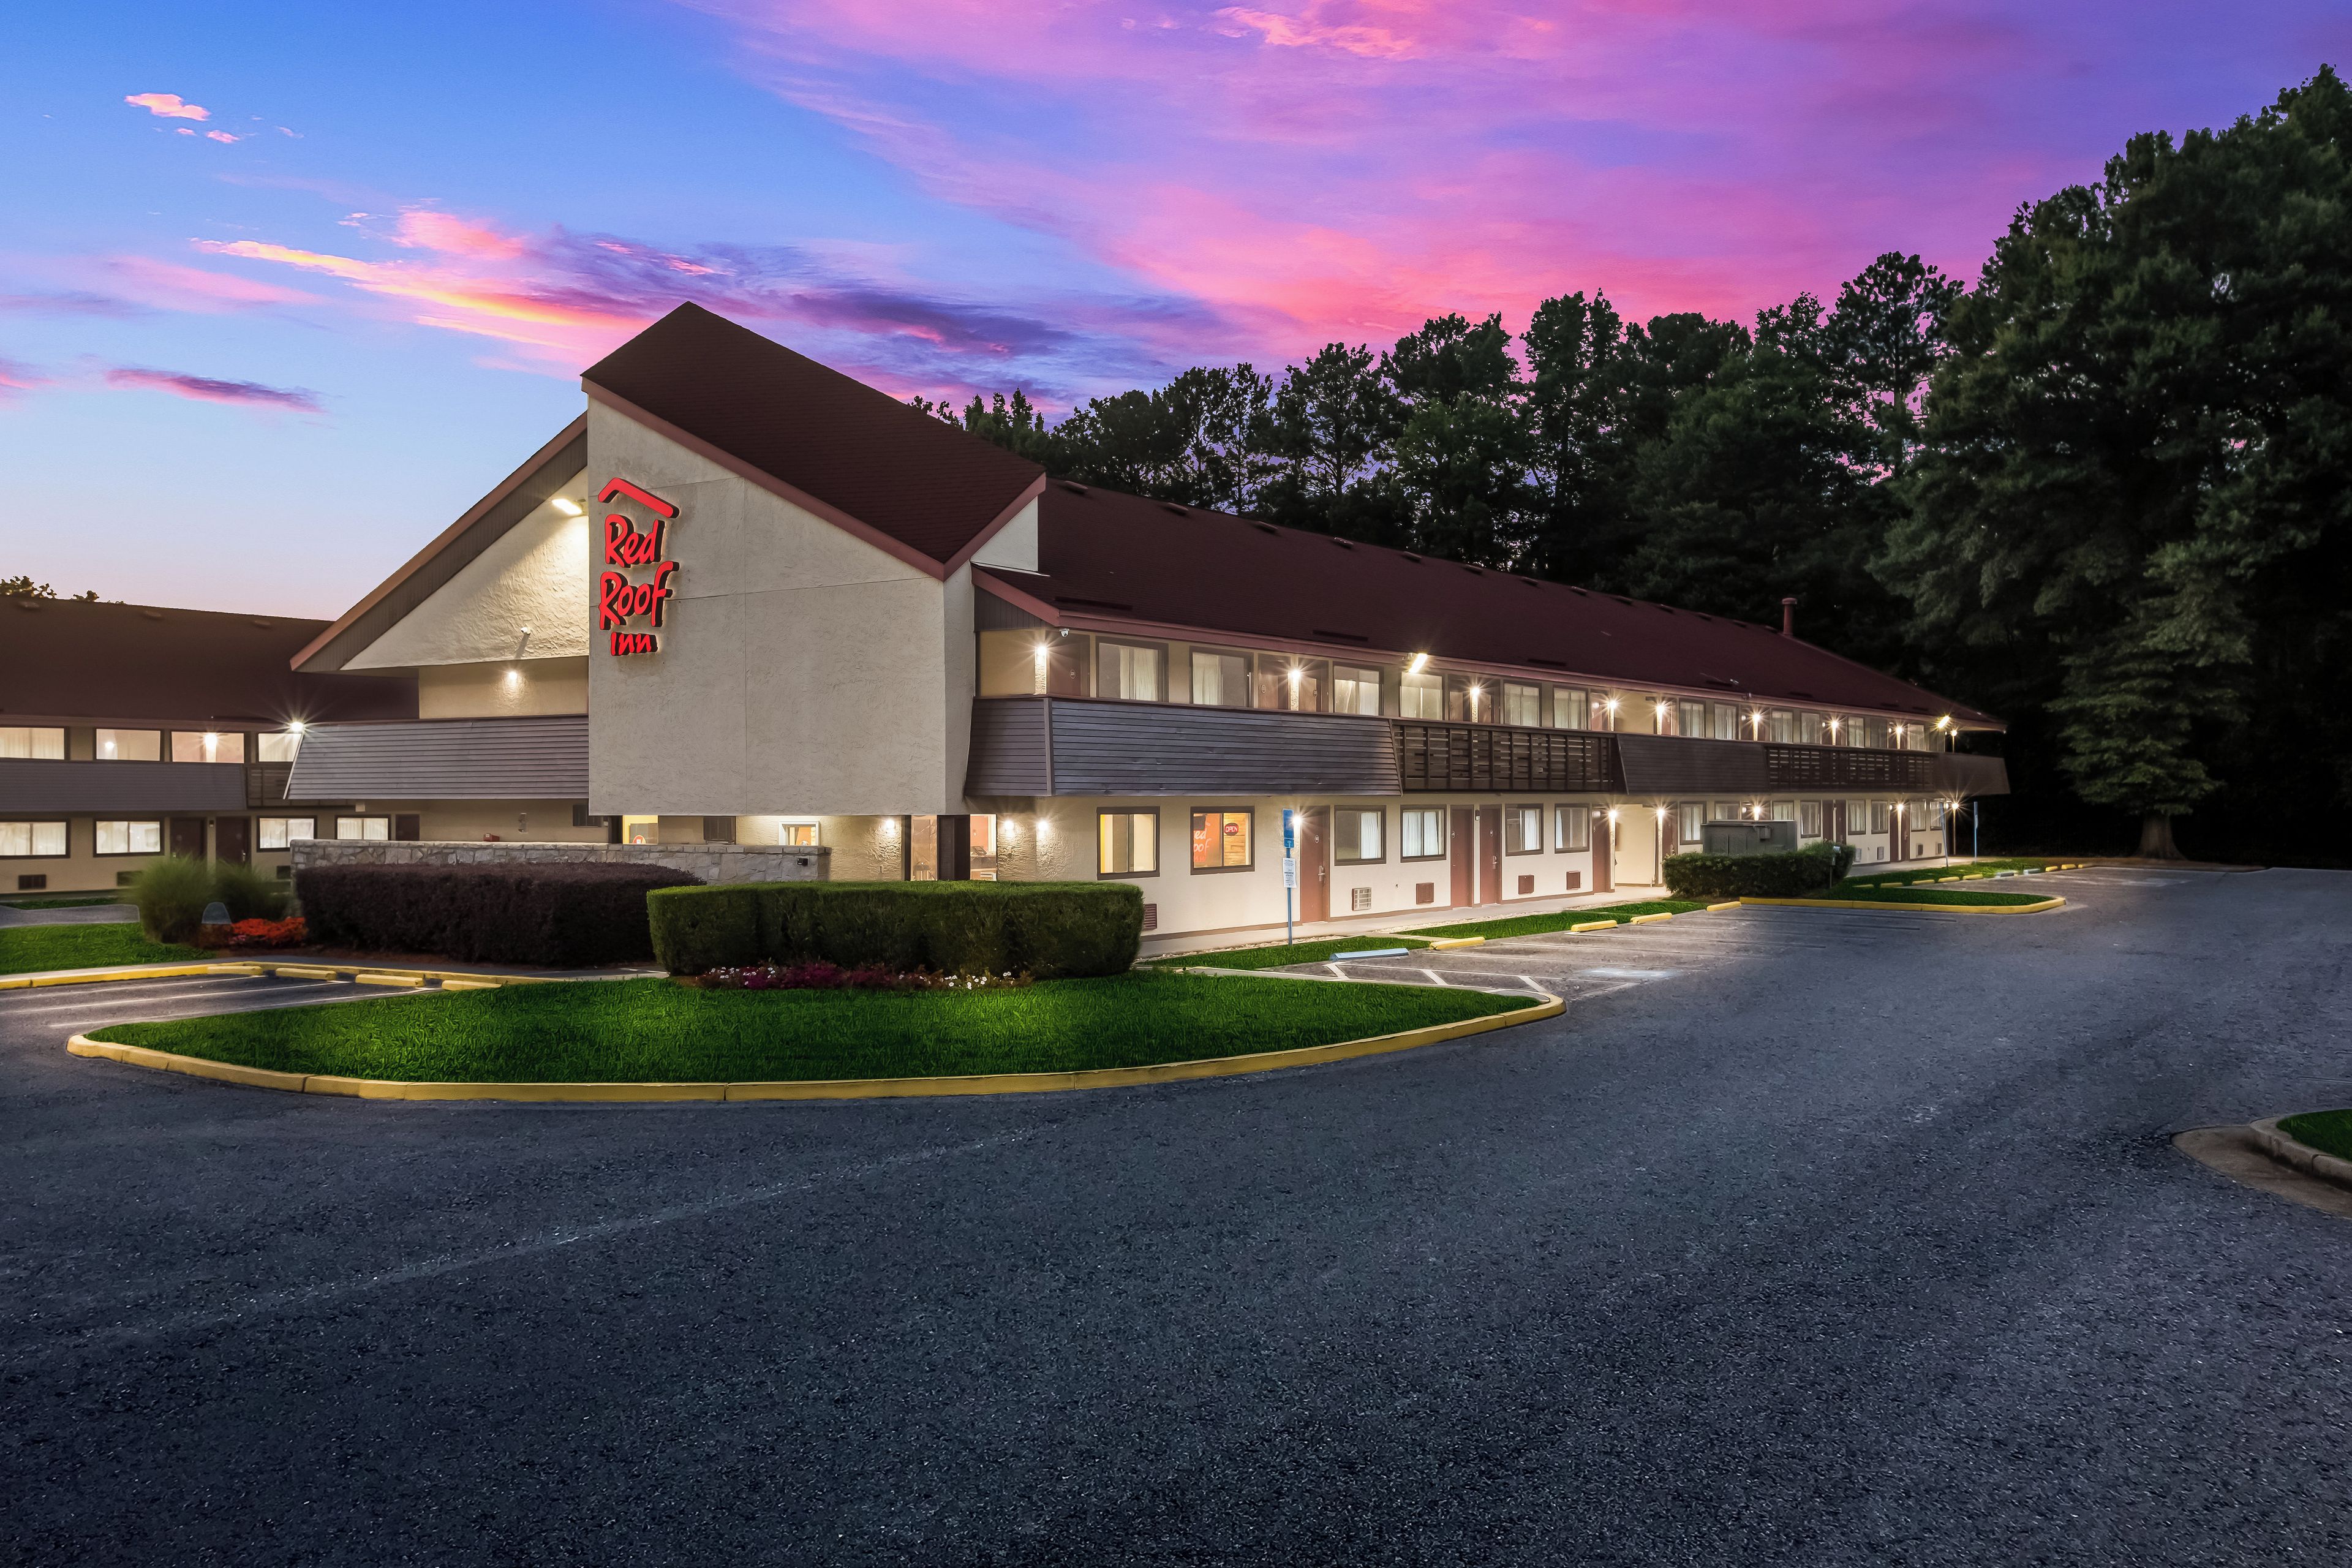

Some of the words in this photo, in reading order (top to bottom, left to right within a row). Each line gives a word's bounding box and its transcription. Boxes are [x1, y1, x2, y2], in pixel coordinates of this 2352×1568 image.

[605, 514, 664, 568] Red
[598, 560, 679, 630] Roof
[1194, 827, 1207, 840] ed
[1194, 838, 1212, 856] oof
